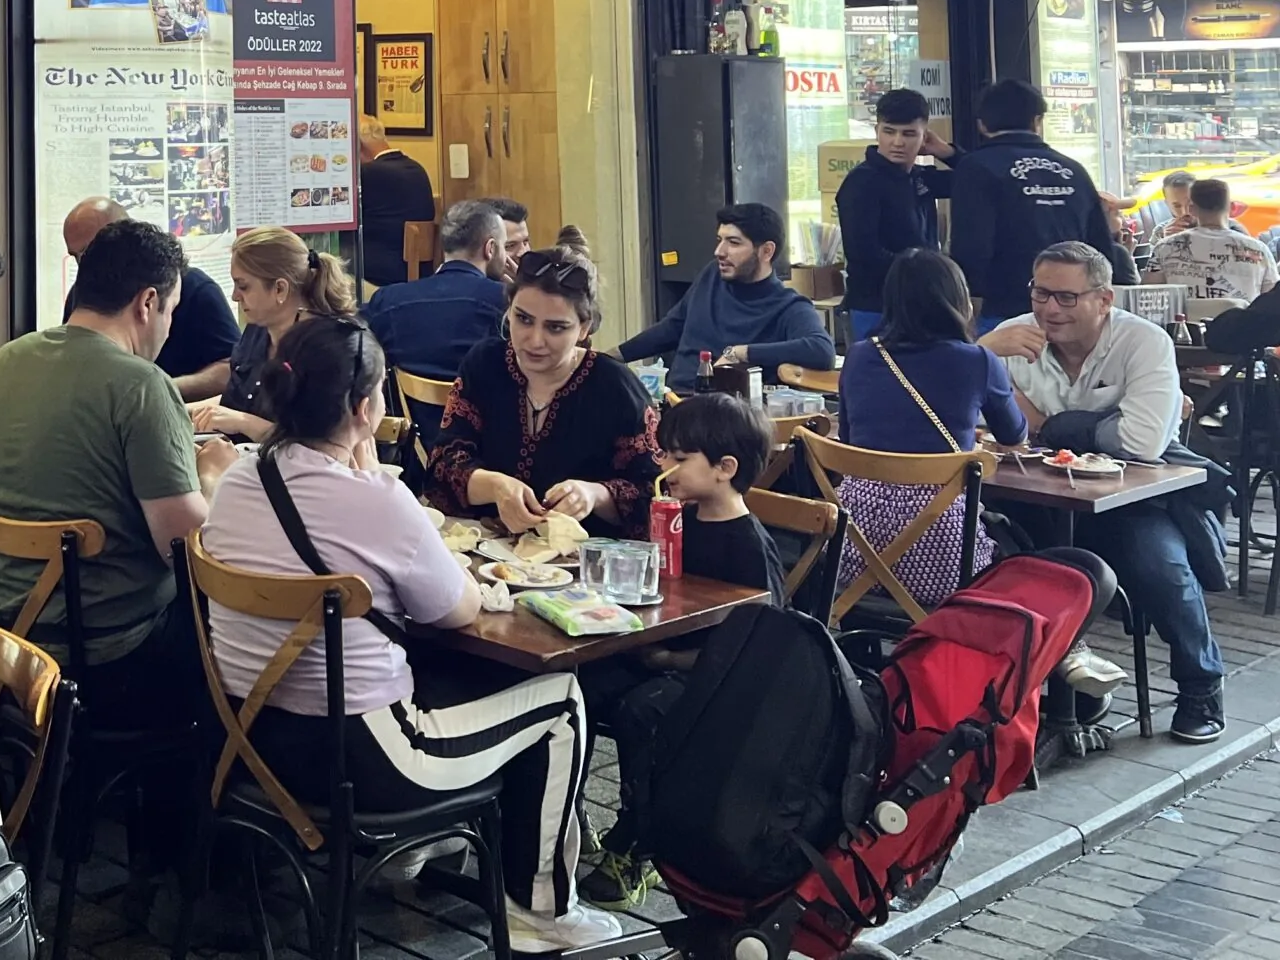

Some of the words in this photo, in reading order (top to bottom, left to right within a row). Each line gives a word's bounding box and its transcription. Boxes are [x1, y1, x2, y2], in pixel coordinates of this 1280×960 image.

[254, 8, 316, 27] tasteatlas
[247, 36, 297, 52] ÖDÜLLER
[299, 40, 323, 52] 2022
[381, 46, 419, 57] HABER
[381, 59, 419, 70] TURK
[257, 66, 266, 75] En
[45, 67, 99, 88] The
[105, 67, 165, 87] New
[170, 68, 214, 90] York
[784, 71, 842, 93] OSTA
[51, 104, 97, 114] Tasting
[929, 97, 951, 116] NIYOR
[58, 114, 92, 123] From
[96, 113, 149, 123] Humble
[53, 125, 68, 133] To
[70, 124, 103, 134] High
[107, 124, 156, 133] Cuisine
